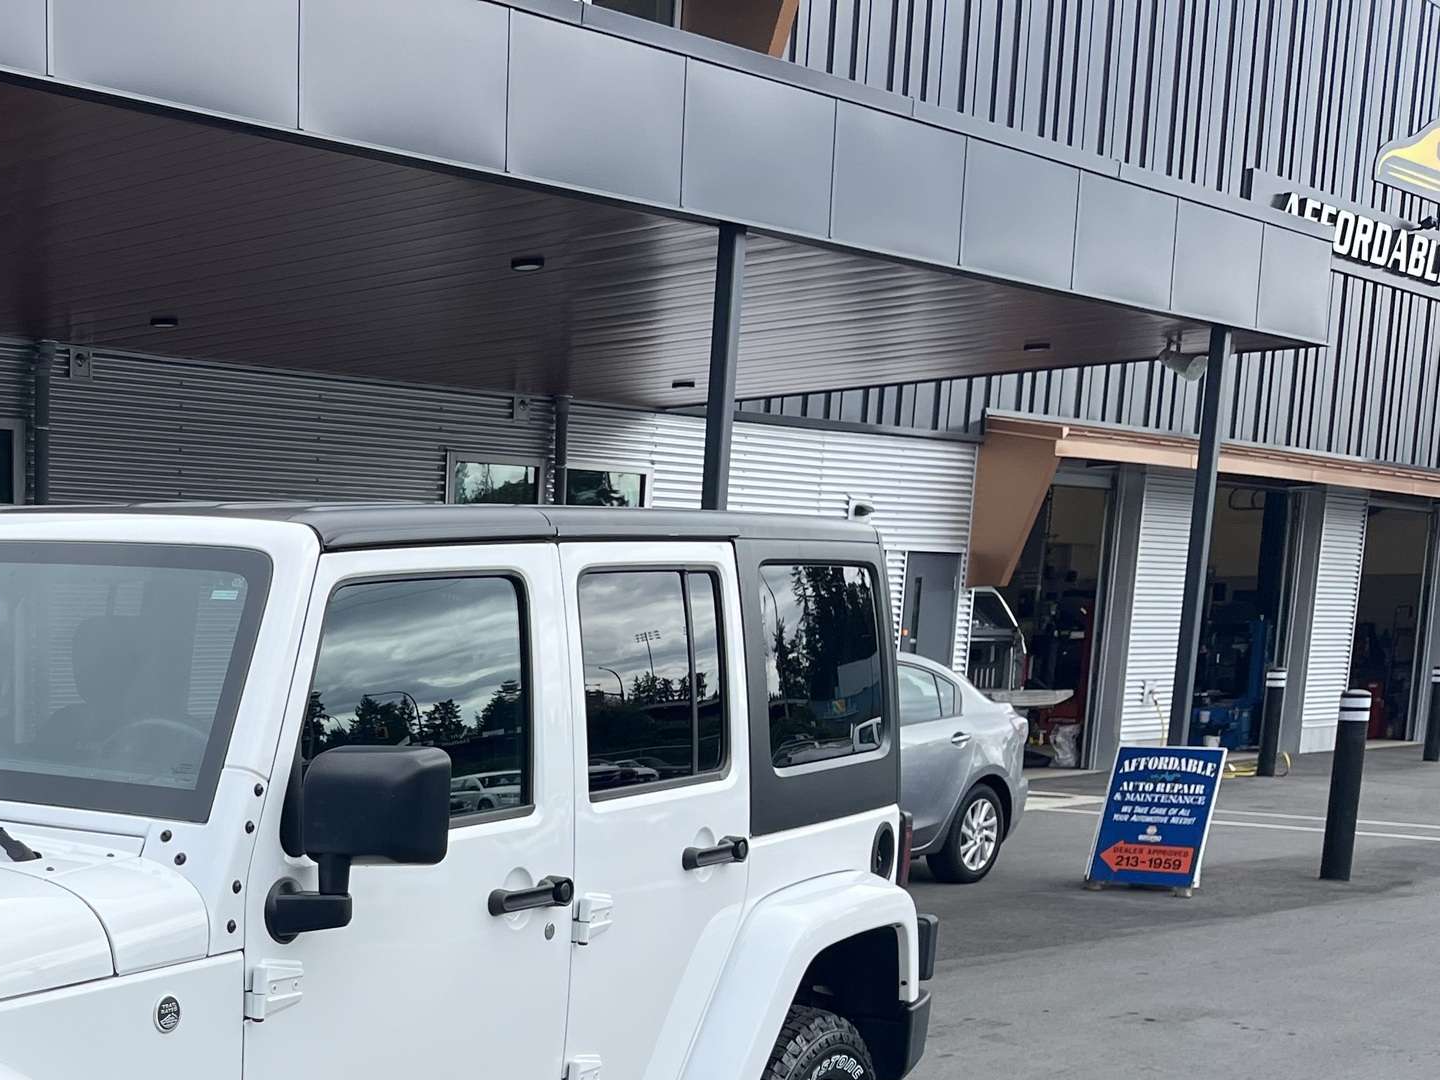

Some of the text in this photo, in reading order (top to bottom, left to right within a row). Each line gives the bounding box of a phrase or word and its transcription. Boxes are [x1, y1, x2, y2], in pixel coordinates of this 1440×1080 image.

[1284, 192, 1440, 284] AFFORDABL
[1119, 756, 1217, 778] AFFORDABLE
[1120, 781, 1205, 794] AUTO REPAIR
[1113, 792, 1206, 805] & MAINTENANCE
[1115, 855, 1182, 871] 213-1959
